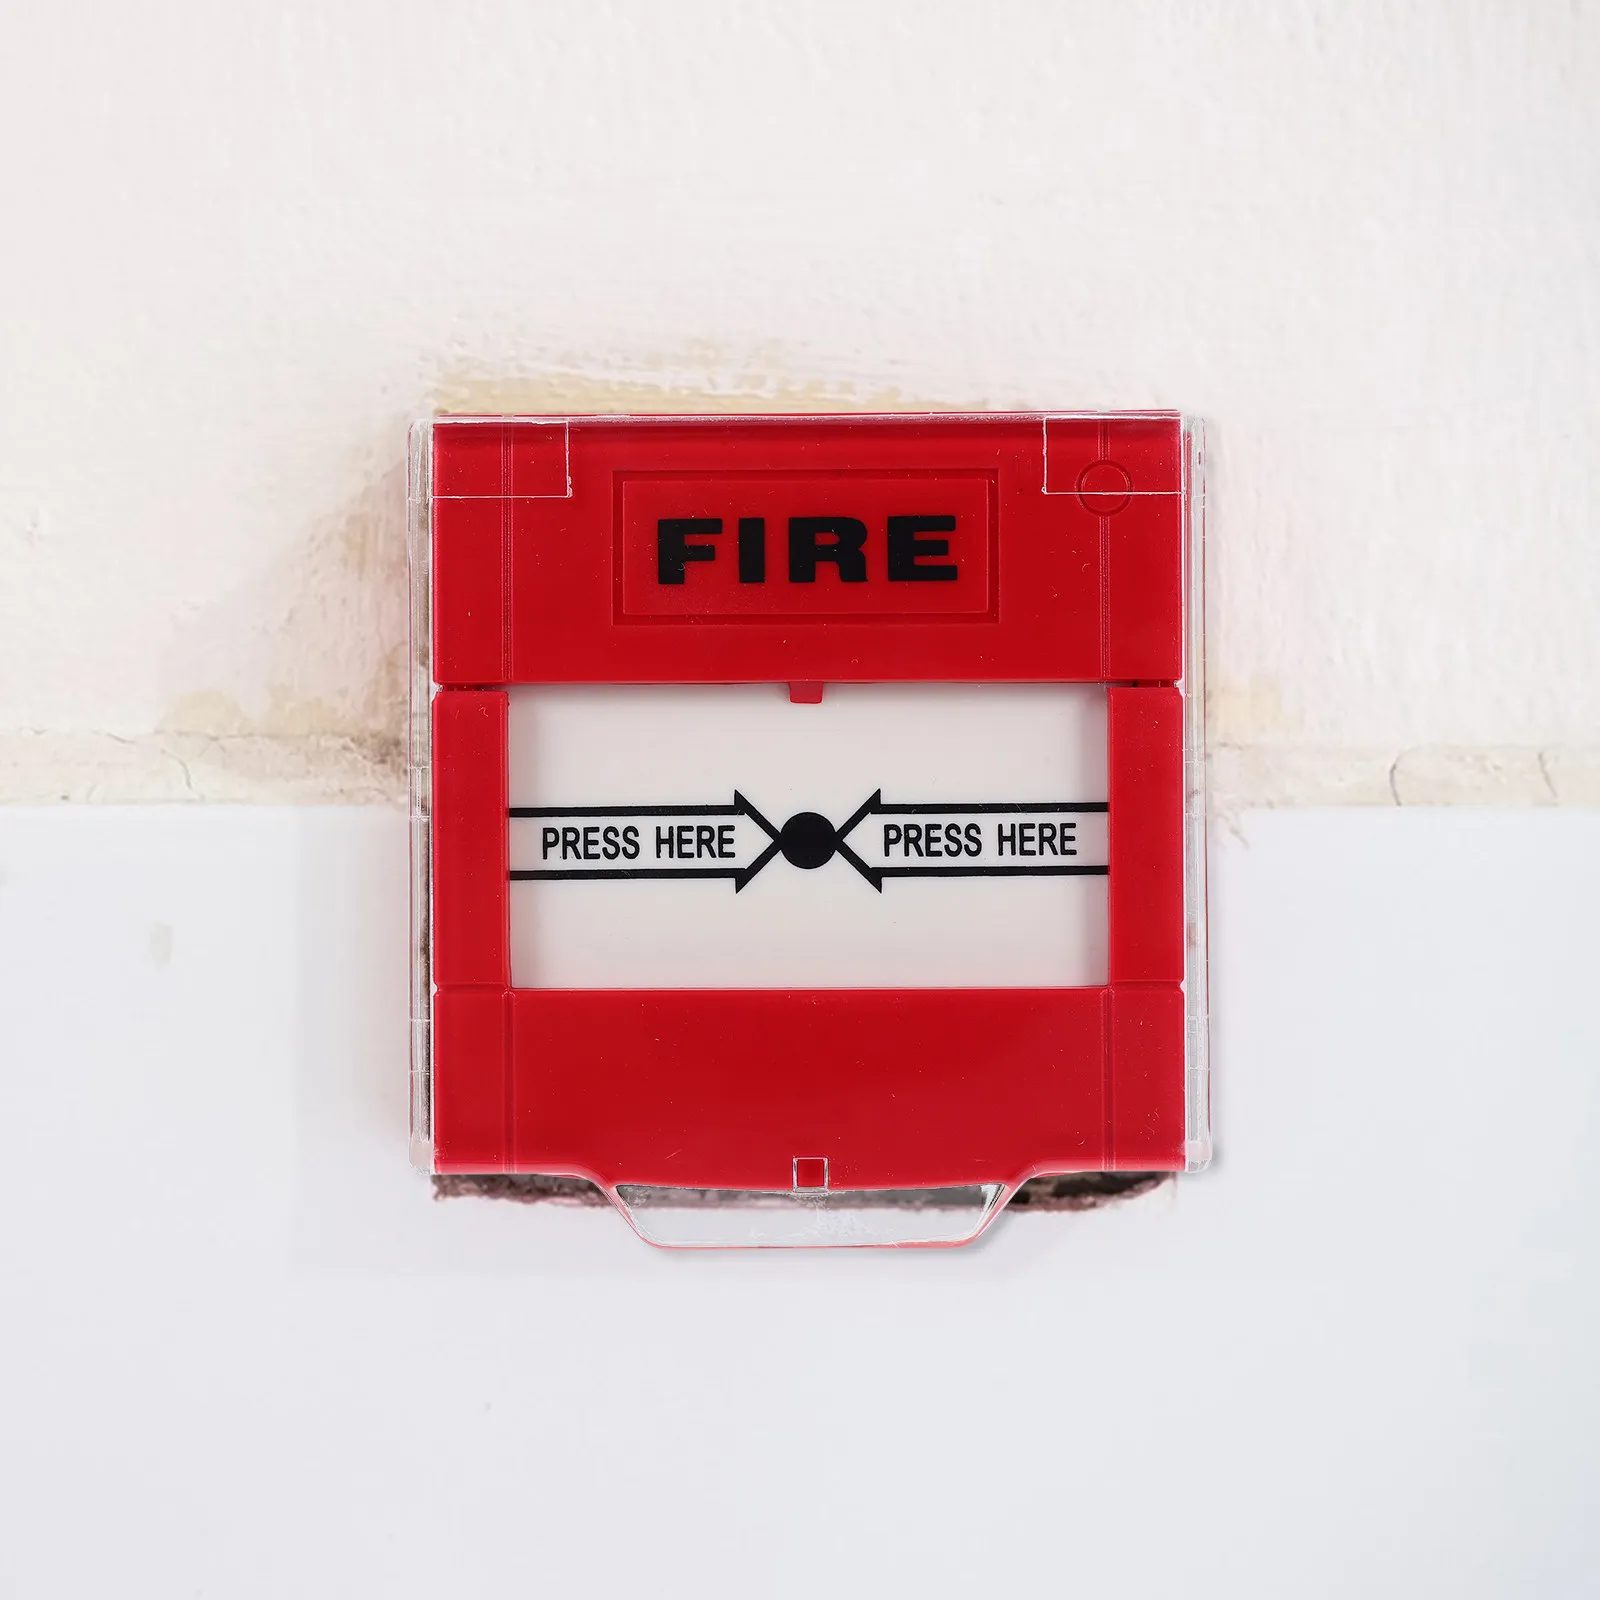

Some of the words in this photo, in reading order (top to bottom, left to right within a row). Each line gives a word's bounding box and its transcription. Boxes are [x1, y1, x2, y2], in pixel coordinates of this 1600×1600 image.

[657, 514, 959, 585] FIRE
[542, 825, 641, 861] PRESS
[655, 824, 736, 859] HERE
[883, 822, 983, 858] PRESS
[997, 822, 1078, 857] HERE
